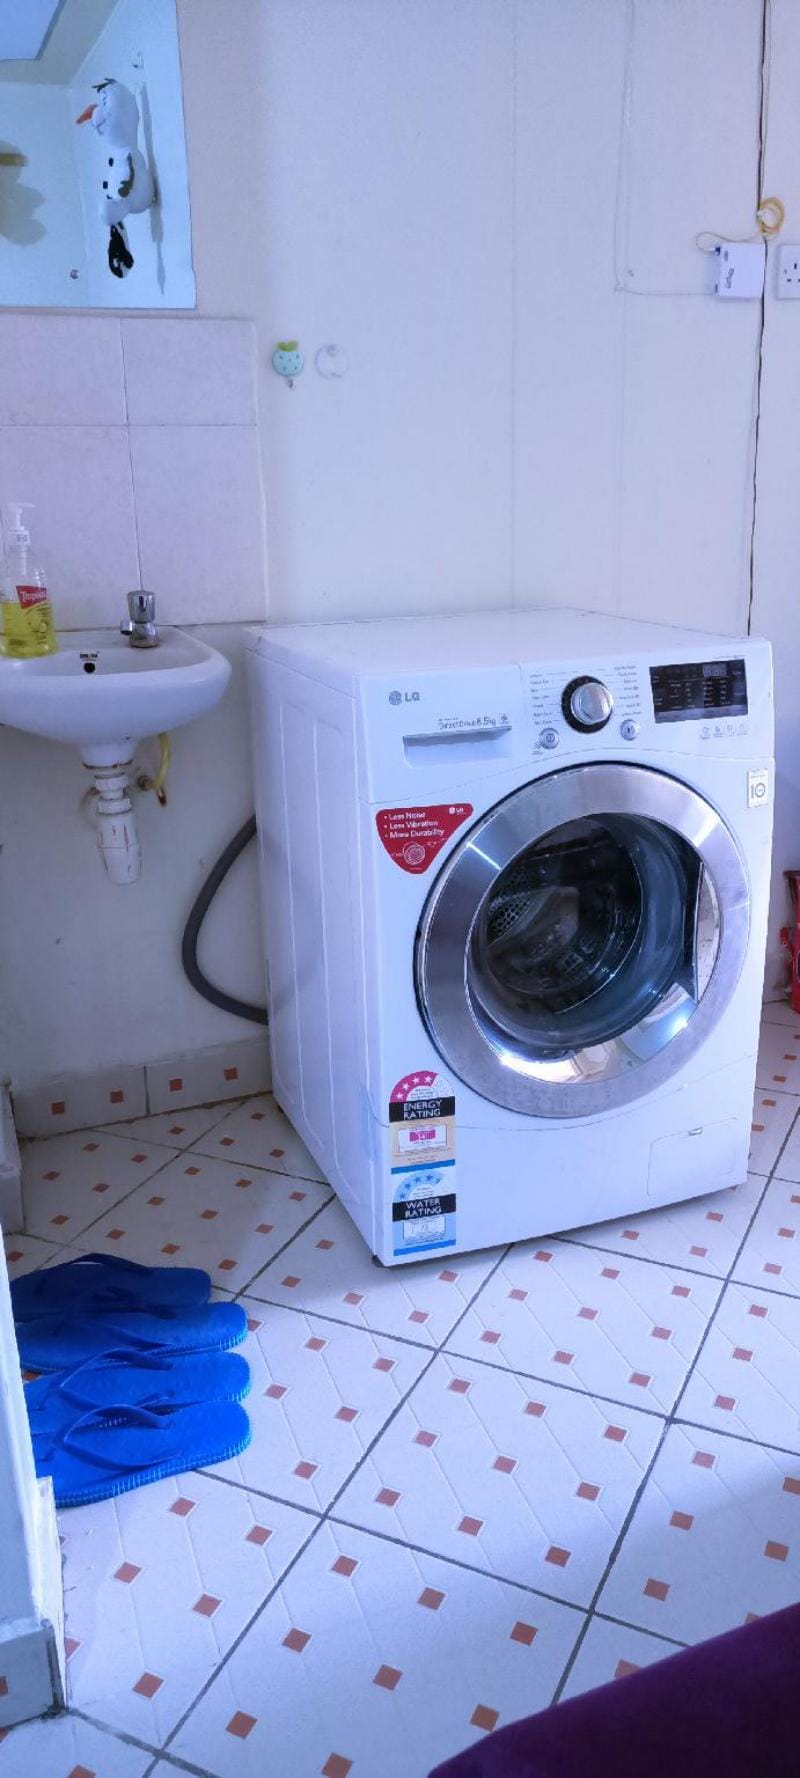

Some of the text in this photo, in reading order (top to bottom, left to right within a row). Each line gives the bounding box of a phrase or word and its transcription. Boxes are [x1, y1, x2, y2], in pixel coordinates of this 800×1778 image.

[404, 691, 420, 702] LG
[406, 820, 438, 829] Vibration
[389, 828, 445, 839] More Durability
[403, 1099, 442, 1111] ENERGY
[403, 1108, 441, 1120] RATING
[405, 1197, 441, 1209] WATER
[404, 1206, 442, 1219] RATING
